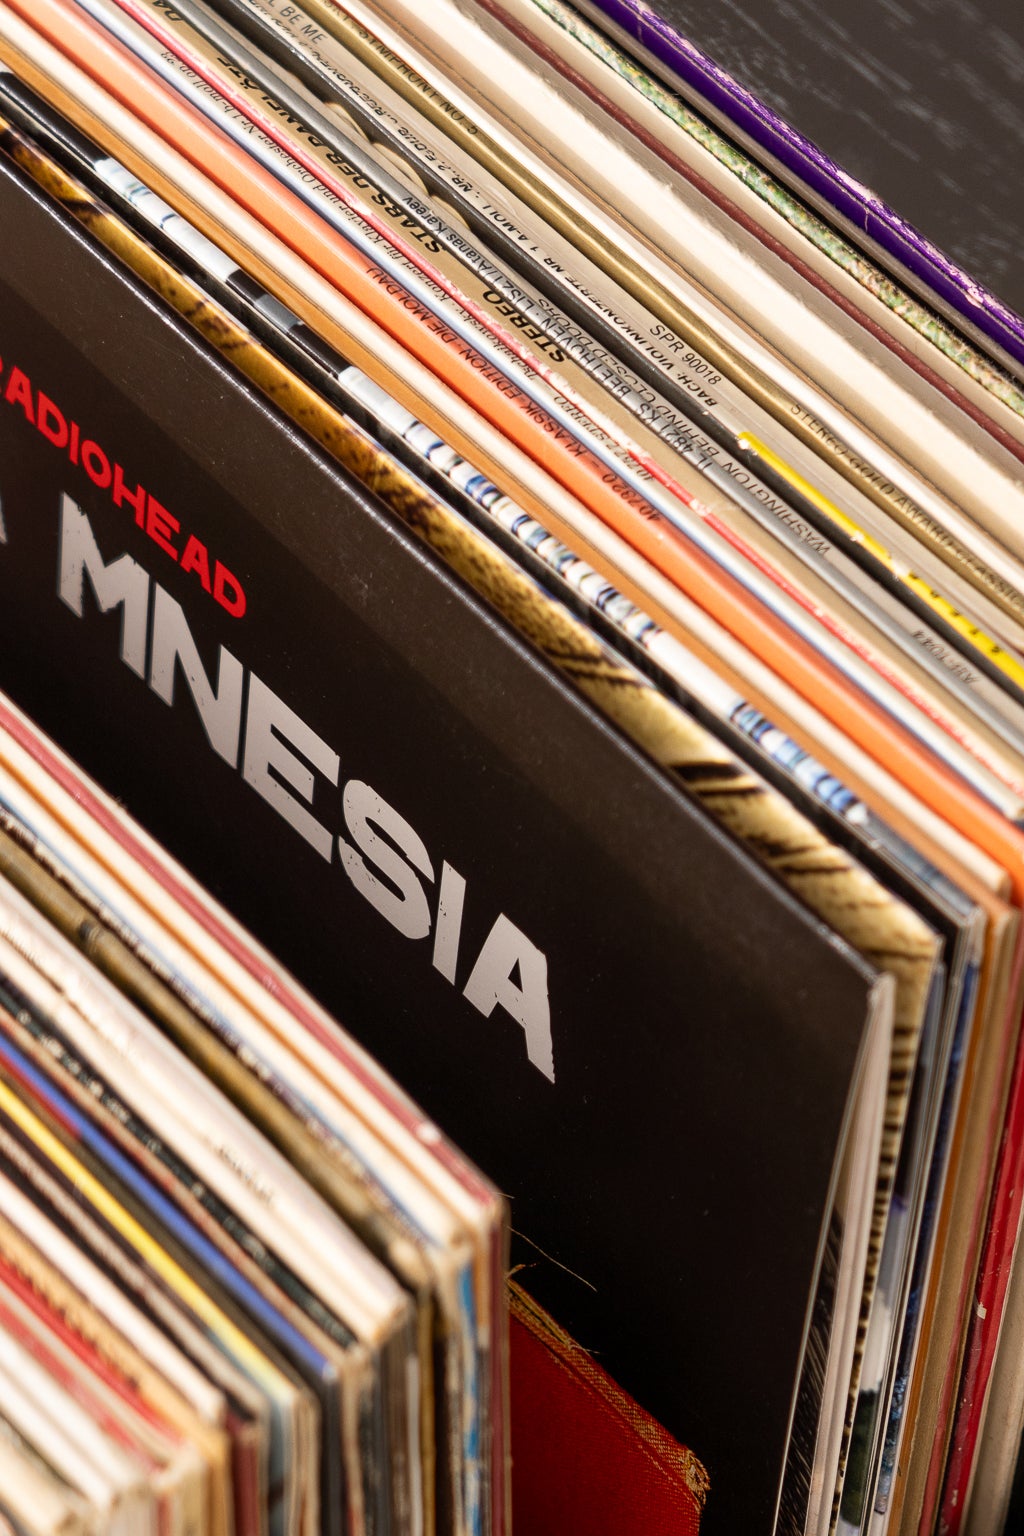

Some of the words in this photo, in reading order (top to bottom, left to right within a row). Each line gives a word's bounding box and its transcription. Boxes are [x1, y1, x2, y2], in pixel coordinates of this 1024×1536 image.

[278, 2, 304, 27] BE
[299, 20, 327, 47] ME
[255, 130, 315, 185] Orchester
[313, 181, 339, 206] und
[400, 192, 447, 238] Kareev
[337, 202, 383, 244] Klavier
[368, 189, 447, 257] STARS
[381, 241, 403, 261] für
[363, 264, 434, 325] MOLDAU
[400, 258, 451, 303] Konzert
[426, 317, 458, 346] DIE
[481, 285, 568, 368] STEREO
[648, 320, 685, 355] SPR
[681, 349, 721, 387] 90018
[538, 315, 631, 400] BEETHOVEN
[634, 400, 661, 427] KS
[656, 400, 719, 459] BEHIND
[657, 421, 695, 457] 4821
[0, 356, 246, 618] ADIOHEAD
[721, 458, 831, 555] WASHINGTON
[57, 491, 556, 1084] MNESIA
